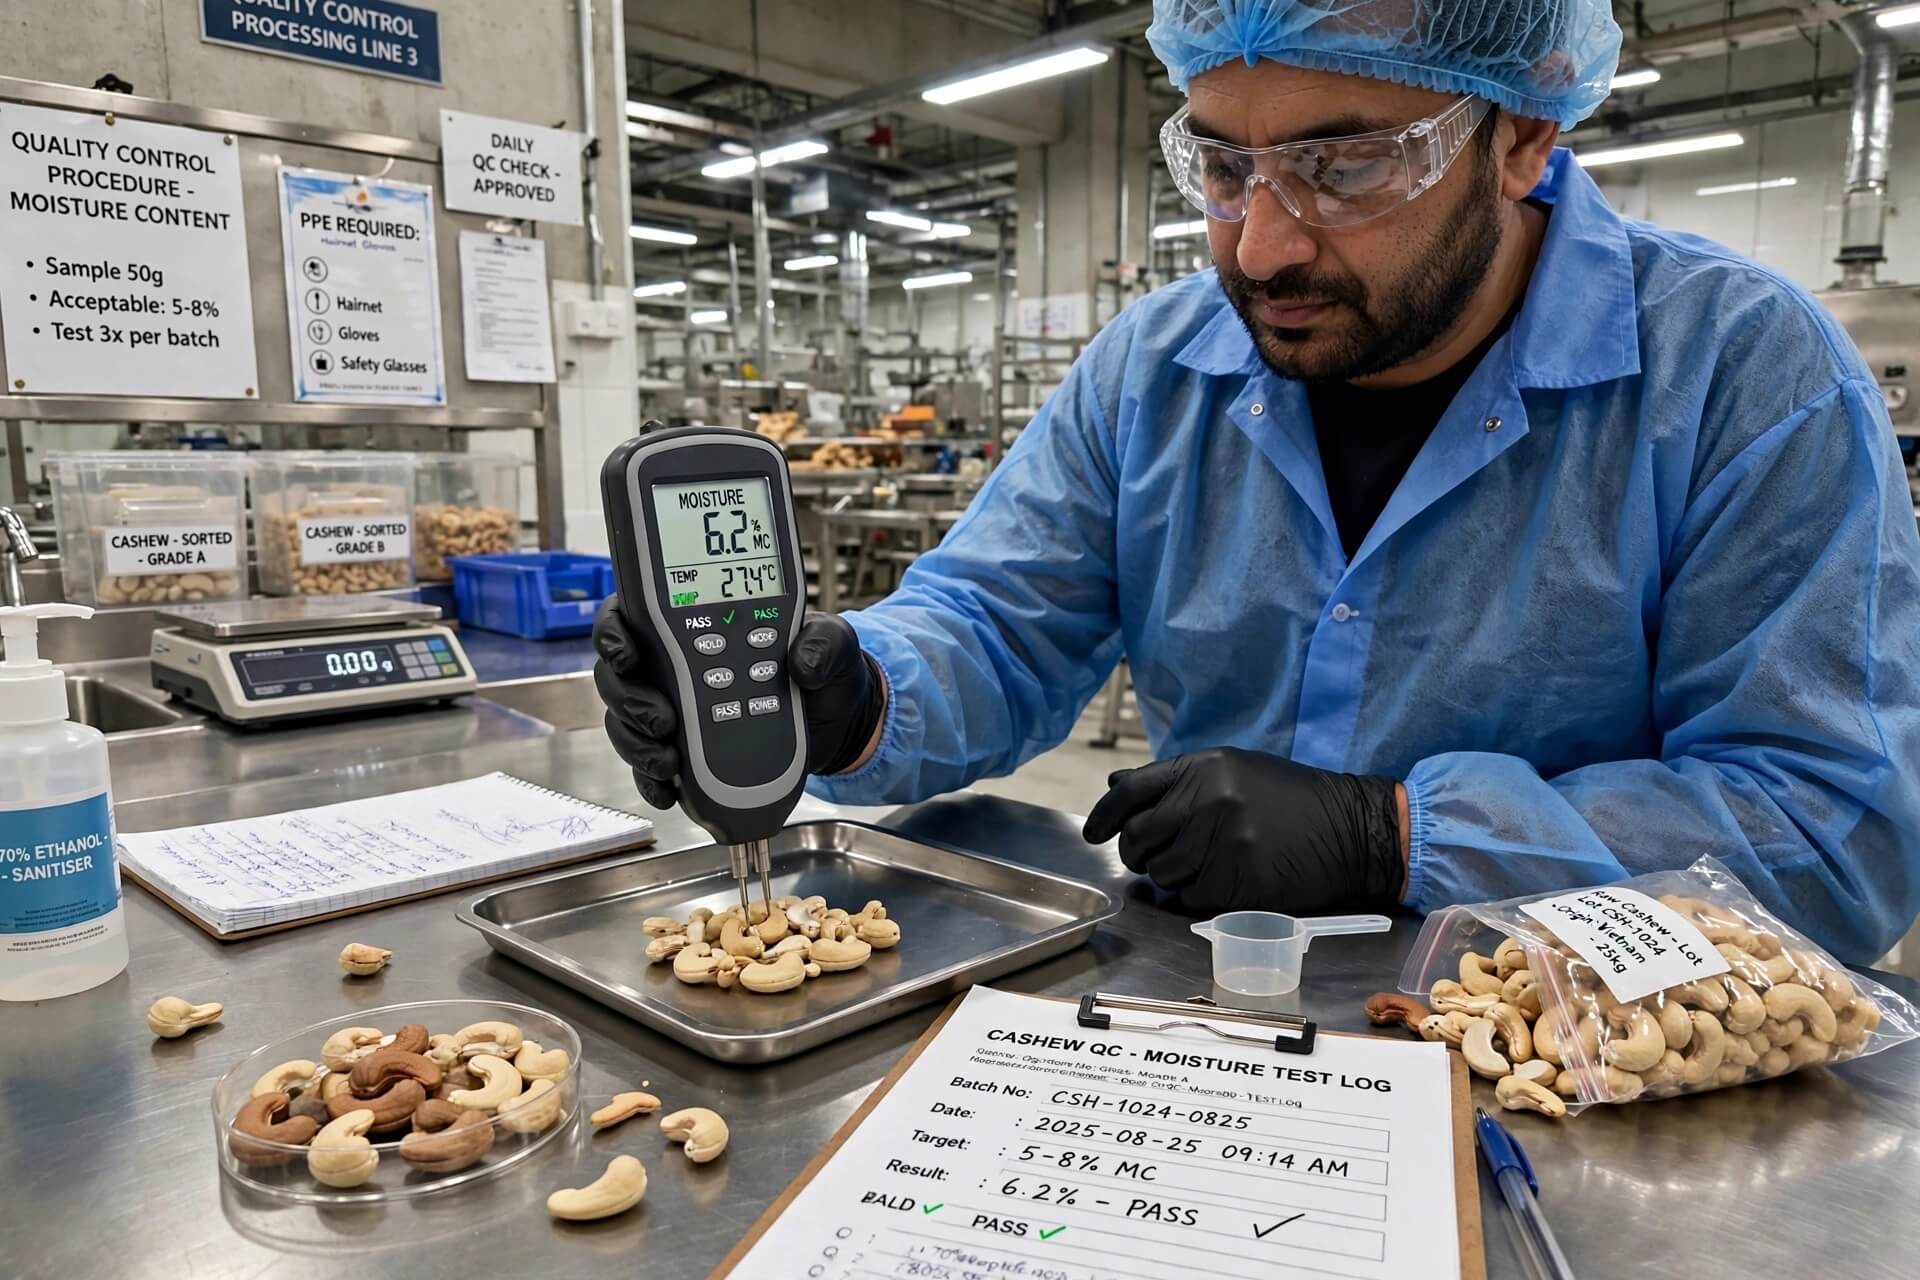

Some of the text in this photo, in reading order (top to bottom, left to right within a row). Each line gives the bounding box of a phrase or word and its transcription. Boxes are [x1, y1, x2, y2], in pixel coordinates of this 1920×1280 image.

[323, 2, 419, 39] CONTROL
[232, 10, 418, 66] PROCESSING LINE 3
[12, 131, 216, 174] QUALITY CONTROL
[491, 133, 534, 154] DAILY
[472, 154, 496, 172] QC
[500, 158, 551, 179] CHECK
[47, 165, 181, 198] PROCEDURE
[473, 178, 555, 202] APPROVED
[10, 191, 231, 230] MOISTURE CONTENT
[300, 212, 420, 241] PPE REQUIRED:
[45, 256, 164, 288] Sample 50g
[49, 290, 220, 318] Acceptable: 5-8%
[336, 296, 383, 313] Hairnet
[51, 321, 220, 349] Test 3x per batch
[338, 326, 380, 342] Gloves
[341, 356, 428, 375] Safety Glasses
[678, 488, 745, 510] MOISTURE
[111, 534, 169, 549] CASHEW
[182, 531, 232, 546] SORTED
[305, 526, 354, 540] CASHEW
[363, 523, 407, 537] SORTED
[703, 510, 748, 556] 6.2
[753, 533, 771, 550] MC
[147, 551, 194, 566] GRADE
[196, 550, 206, 564] A
[336, 541, 374, 554] GRADE
[377, 540, 385, 553] B
[670, 569, 698, 584] TEMP
[685, 607, 780, 630] PASS PASS
[698, 631, 775, 651] HOLD MODE
[326, 650, 394, 676] 0.00 g
[750, 664, 775, 677] MODE
[715, 698, 778, 718] PASS POWER
[0, 847, 31, 863] 70%
[34, 832, 103, 860] ETHANOL
[12, 855, 94, 882] SANITISER
[1577, 895, 1667, 957] Lot CSH-1024
[1621, 902, 1672, 937] Cashew
[1678, 943, 1704, 967] Lot
[1598, 922, 1646, 964] Vietnam
[1595, 943, 1628, 975] 25kg
[986, 1029, 1086, 1051] CASHEW
[1089, 1043, 1124, 1058] QC
[1143, 1048, 1266, 1078] MOISTURE
[1272, 1065, 1333, 1086] TEST
[1340, 1074, 1392, 1093] LOG
[949, 1076, 1252, 1130] Batch No: CSH-1024-0825
[930, 1102, 976, 1119] Date:
[1034, 1116, 1203, 1154] 2025-08-25
[1220, 1144, 1296, 1169] 09:14
[1307, 1158, 1349, 1177] AM
[911, 1128, 971, 1151] Target:
[1018, 1145, 1101, 1172] 5-8%
[1114, 1161, 1158, 1182] MC
[885, 1158, 950, 1182] Result:
[1001, 1177, 1080, 1206] 6.2%
[1125, 1199, 1200, 1227] PASS
[971, 1214, 1029, 1237] PASS
